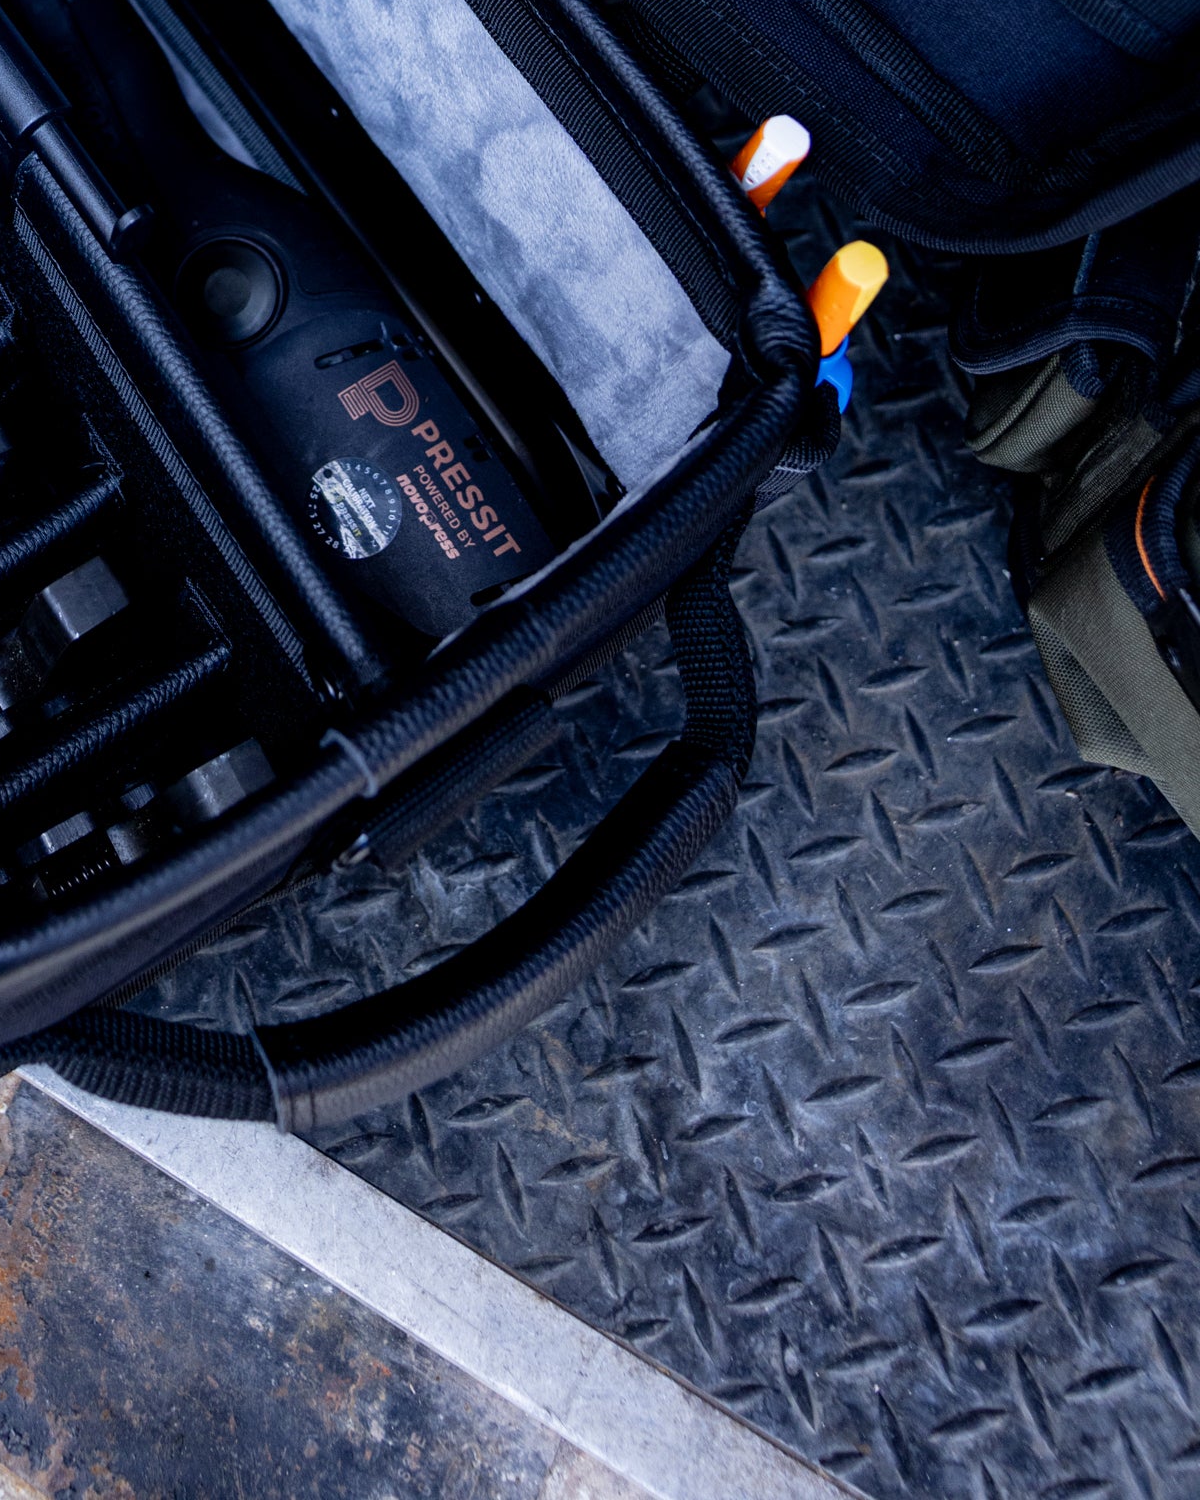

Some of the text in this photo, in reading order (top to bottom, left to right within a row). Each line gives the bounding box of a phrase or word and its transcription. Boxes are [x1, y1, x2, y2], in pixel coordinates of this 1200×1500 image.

[342, 478, 378, 529] CALIBRATION
[358, 487, 376, 509] NEXT
[364, 466, 371, 474] 5
[372, 472, 380, 480] 6
[388, 509, 396, 520] 10
[411, 418, 522, 557] PRESSIT
[412, 464, 476, 548] POWERED BY
[313, 522, 326, 535] 27
[325, 536, 340, 549] 28
[336, 502, 362, 537] PRESSIT
[396, 474, 460, 560] novopress
